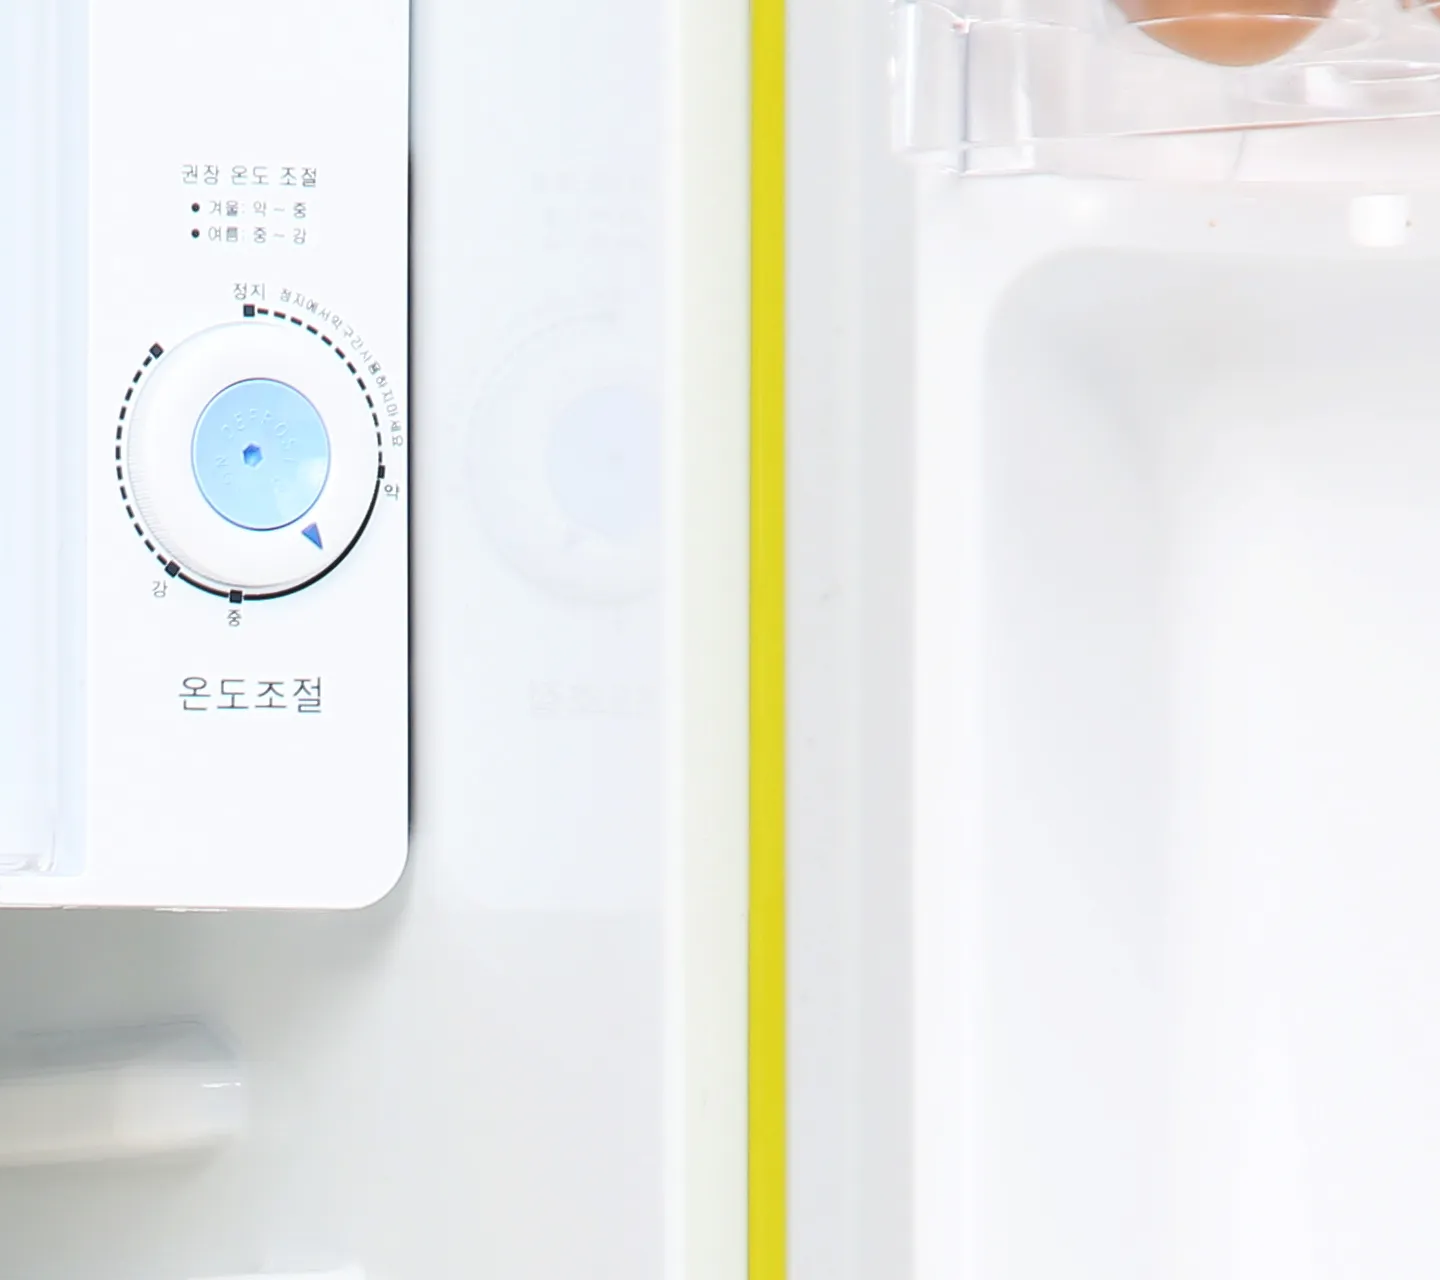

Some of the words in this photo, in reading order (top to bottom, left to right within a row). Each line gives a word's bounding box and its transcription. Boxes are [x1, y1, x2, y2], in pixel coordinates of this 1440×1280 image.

[180, 163, 221, 185] 권장
[230, 165, 270, 187] 온도
[278, 165, 319, 188] 조절
[252, 200, 268, 218] 약
[292, 202, 308, 219] 중
[252, 226, 268, 244] 중
[292, 227, 308, 245] 강
[232, 282, 267, 301] 정지
[383, 483, 401, 501] 약
[151, 580, 169, 599] 강
[226, 607, 243, 628] 중
[178, 674, 323, 714] 온도조절
